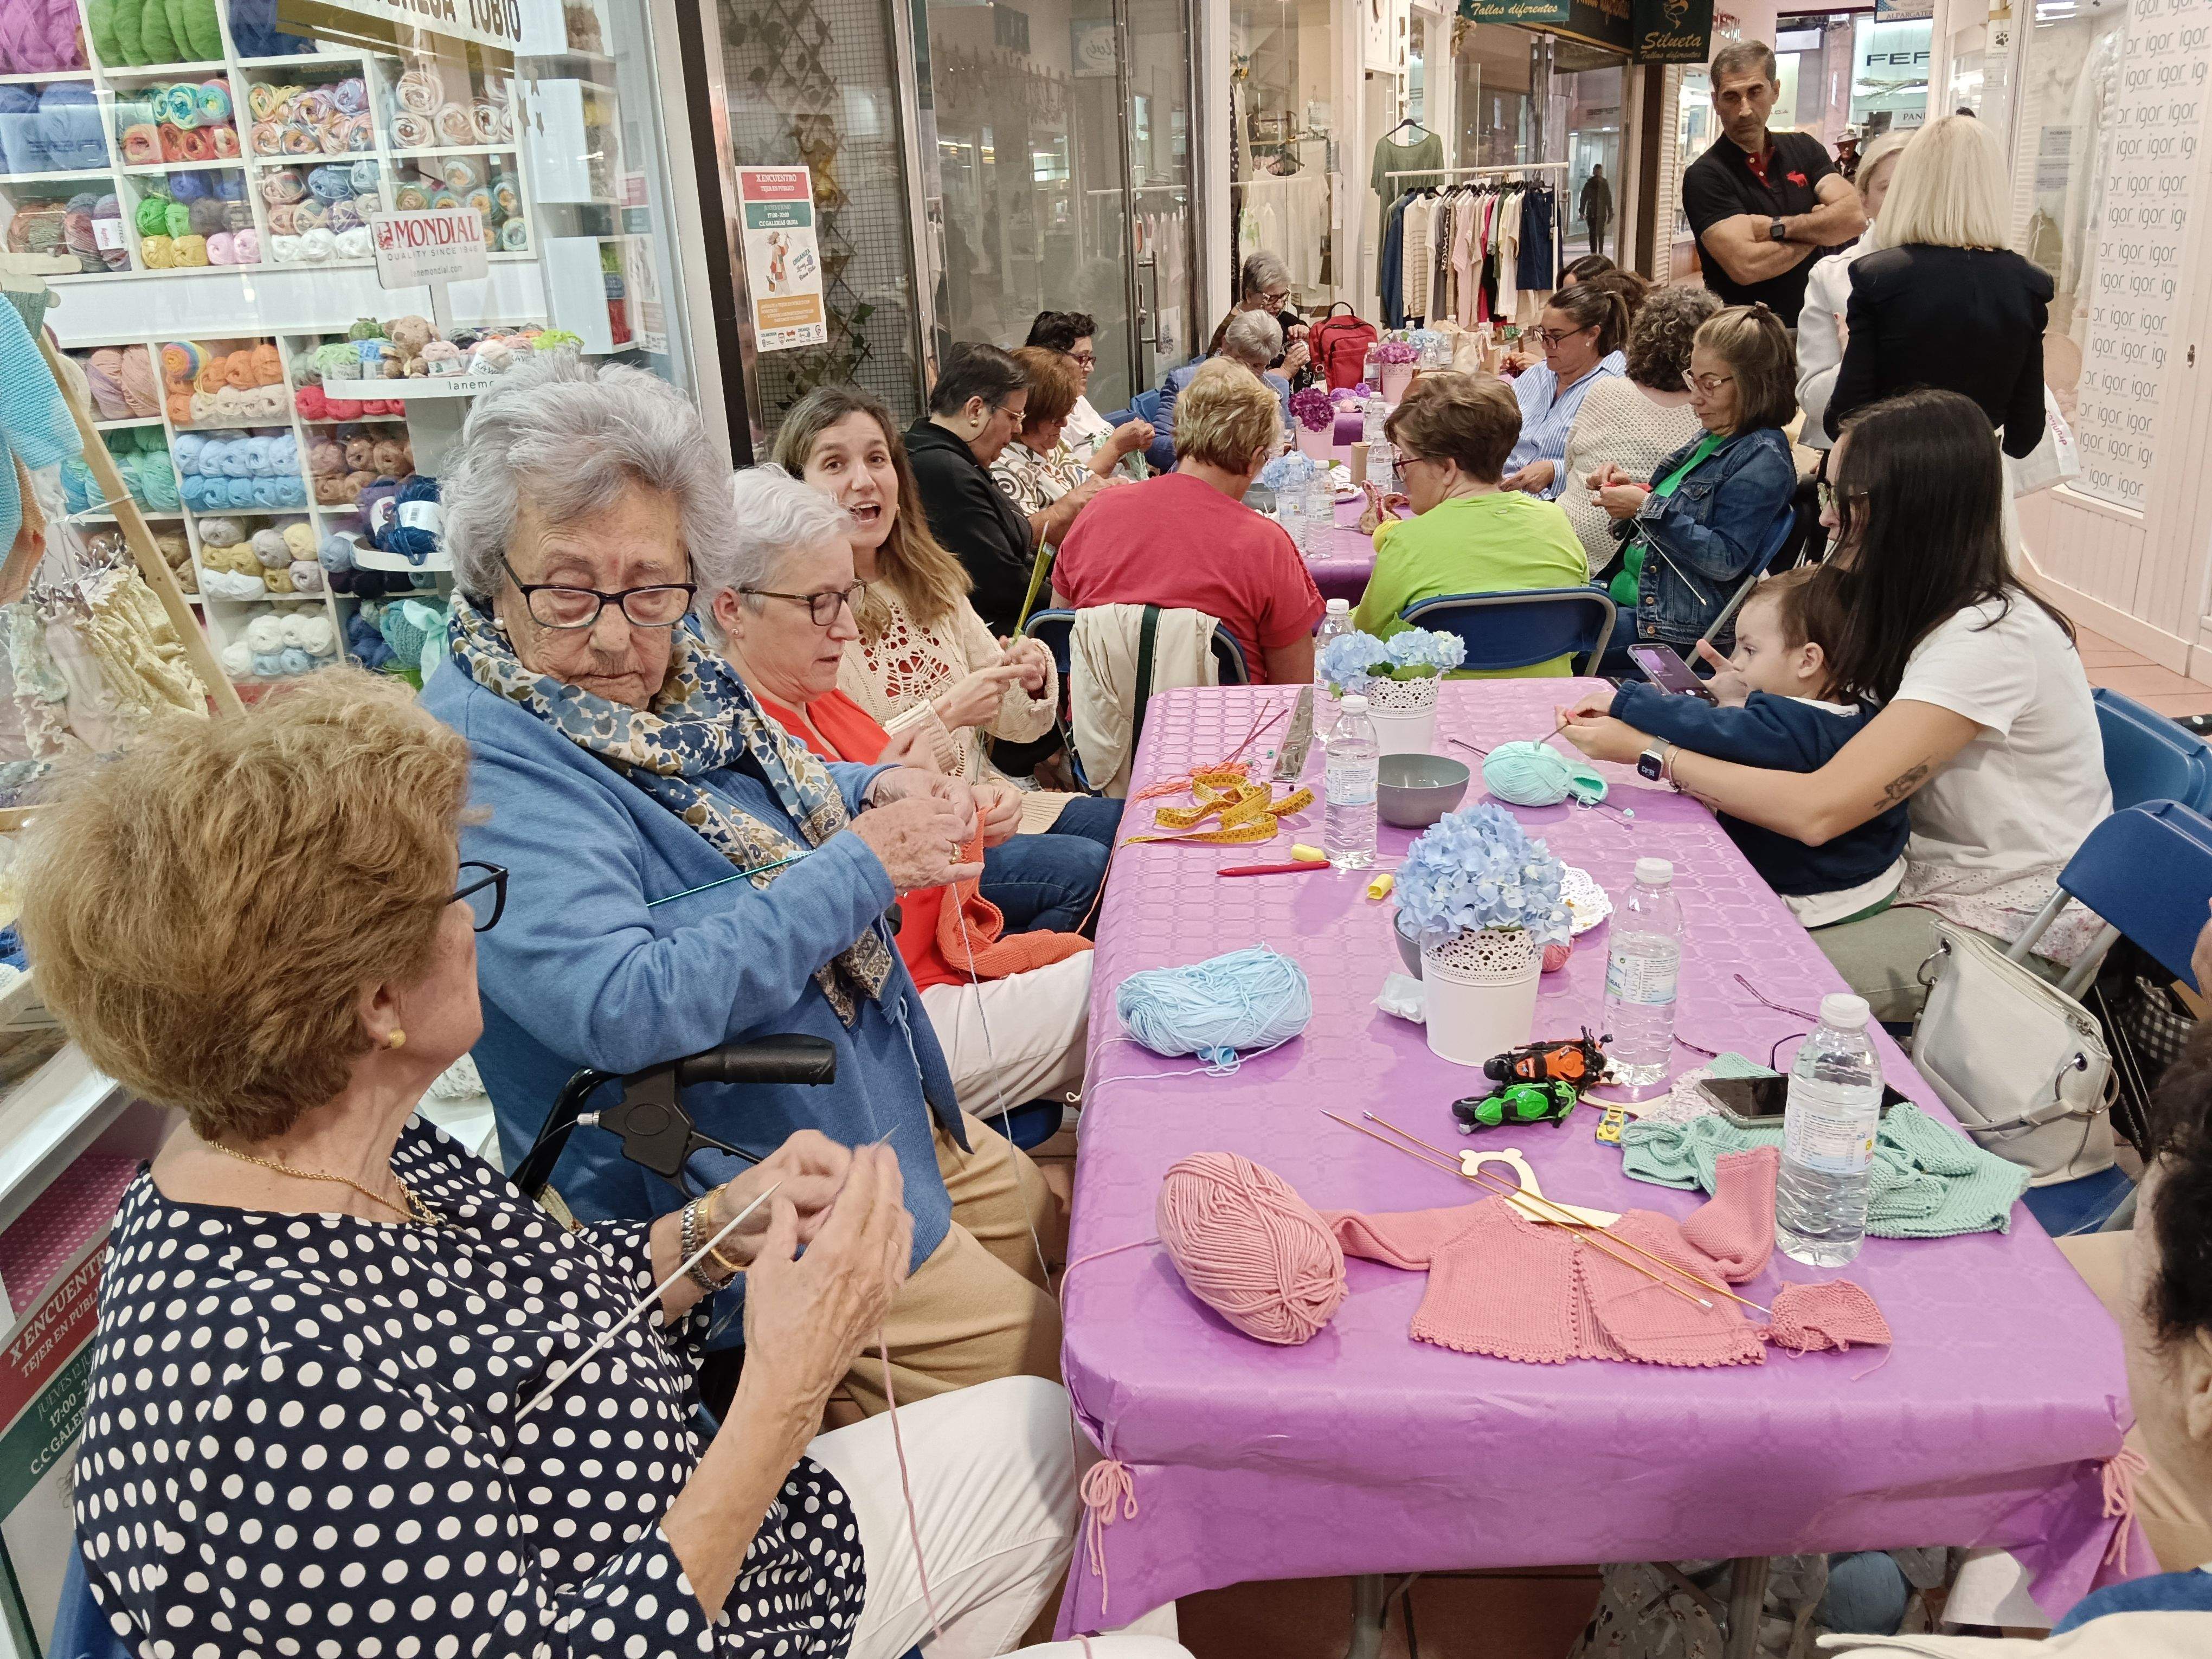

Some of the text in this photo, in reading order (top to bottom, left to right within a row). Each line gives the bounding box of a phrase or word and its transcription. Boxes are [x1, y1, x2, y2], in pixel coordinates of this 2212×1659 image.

[1470, 2, 1506, 15] Tallas
[1508, 1, 1559, 18] diferentes
[1641, 31, 1702, 49] Silueta
[2145, 30, 2174, 59] igor
[2179, 24, 2209, 54] igor
[2125, 66, 2152, 93] igor
[2157, 61, 2186, 89] igor
[2136, 101, 2164, 129] igor
[2169, 99, 2197, 127] igor
[2116, 134, 2143, 162] igor
[2147, 133, 2176, 161] igor
[762, 174, 797, 182] ENCUENTRO
[2127, 171, 2153, 198] igor
[2158, 170, 2187, 198] igor
[2108, 202, 2133, 228] igor
[2138, 202, 2165, 230] igor
[394, 216, 480, 248] MONDIAL
[388, 249, 427, 261] QUALITY
[431, 247, 456, 257] SINCE
[793, 248, 811, 266] ORGANIZA
[2119, 238, 2144, 265] igor
[2149, 240, 2177, 268] igor
[411, 265, 463, 278] lanemondial.com
[2100, 267, 2125, 294] igor
[2130, 271, 2156, 297] igor
[2110, 304, 2135, 331] igor
[2140, 308, 2167, 336] igor
[2092, 332, 2116, 358] igor
[2121, 336, 2146, 363] igor
[2102, 369, 2126, 395] igor
[2131, 374, 2158, 401] igor
[2098, 401, 2122, 427] igor
[2127, 408, 2152, 435] igor
[2080, 426, 2104, 452] igor
[2108, 434, 2133, 460] igor
[2089, 464, 2144, 499] igor igor
[9, 1340, 23, 1367] X
[22, 1338, 55, 1378] TEJER
[53, 1319, 69, 1344] EN
[37, 1373, 72, 1422] JUEVES
[49, 1392, 77, 1429] 17:00
[81, 1375, 90, 1390] 2
[30, 1447, 52, 1475] C.C
